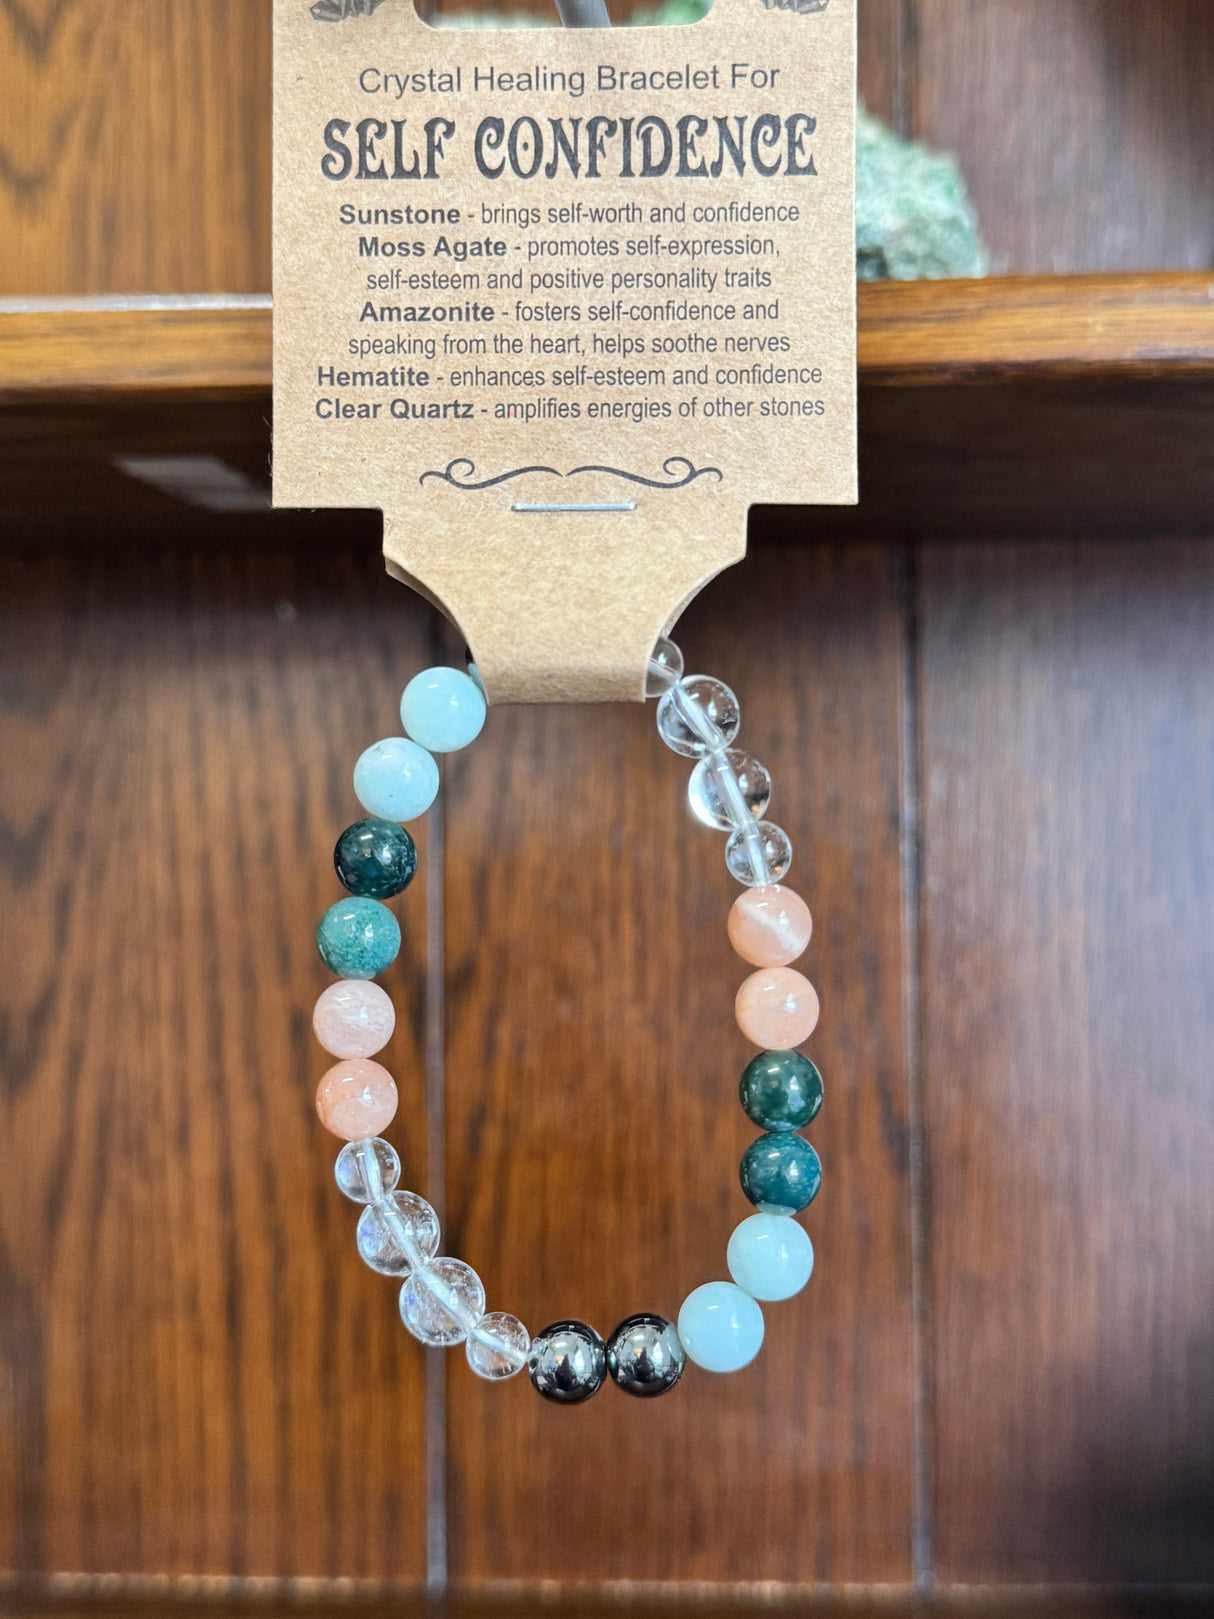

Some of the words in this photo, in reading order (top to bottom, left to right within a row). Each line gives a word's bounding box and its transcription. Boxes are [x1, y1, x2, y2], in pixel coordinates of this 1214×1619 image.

[360, 66, 461, 99] Crystal
[474, 66, 584, 97] Healing
[598, 64, 720, 91] Bracelet
[732, 63, 780, 88] For
[321, 117, 455, 181] SELF
[474, 113, 818, 180] CONFIDENCE
[339, 204, 460, 225] Sunstone
[482, 203, 541, 229] brings
[548, 202, 642, 223] self-worth
[650, 202, 685, 223] and
[693, 201, 799, 222] confidence
[359, 236, 425, 257] Moss
[433, 236, 507, 262] Agate
[528, 236, 619, 261] promotes
[626, 234, 779, 260] self-expression,
[366, 269, 479, 291] self-esteem
[487, 268, 522, 289] and
[531, 268, 604, 294] positive
[612, 267, 718, 293] personality
[725, 267, 771, 287] traits
[359, 301, 494, 322] Amazonite
[515, 301, 581, 321] fosters
[588, 300, 735, 321] self-confidence
[743, 299, 778, 319] and
[349, 334, 435, 359] speaking
[443, 333, 486, 354] from
[493, 333, 523, 354] the
[531, 333, 585, 356] heart,
[593, 333, 645, 358] helps
[652, 333, 717, 353] soothe
[725, 336, 790, 352] nerves
[318, 366, 429, 387] Hematite
[450, 365, 545, 387] enhances
[552, 365, 665, 386] self-esteem
[673, 364, 708, 385] and
[716, 364, 822, 384] confidence
[316, 398, 382, 419] Clear
[390, 398, 474, 420] Quartz
[495, 398, 581, 423] amplifies
[587, 399, 671, 423] energies
[679, 397, 698, 417] of
[703, 396, 754, 417] other
[760, 397, 824, 416] stones
